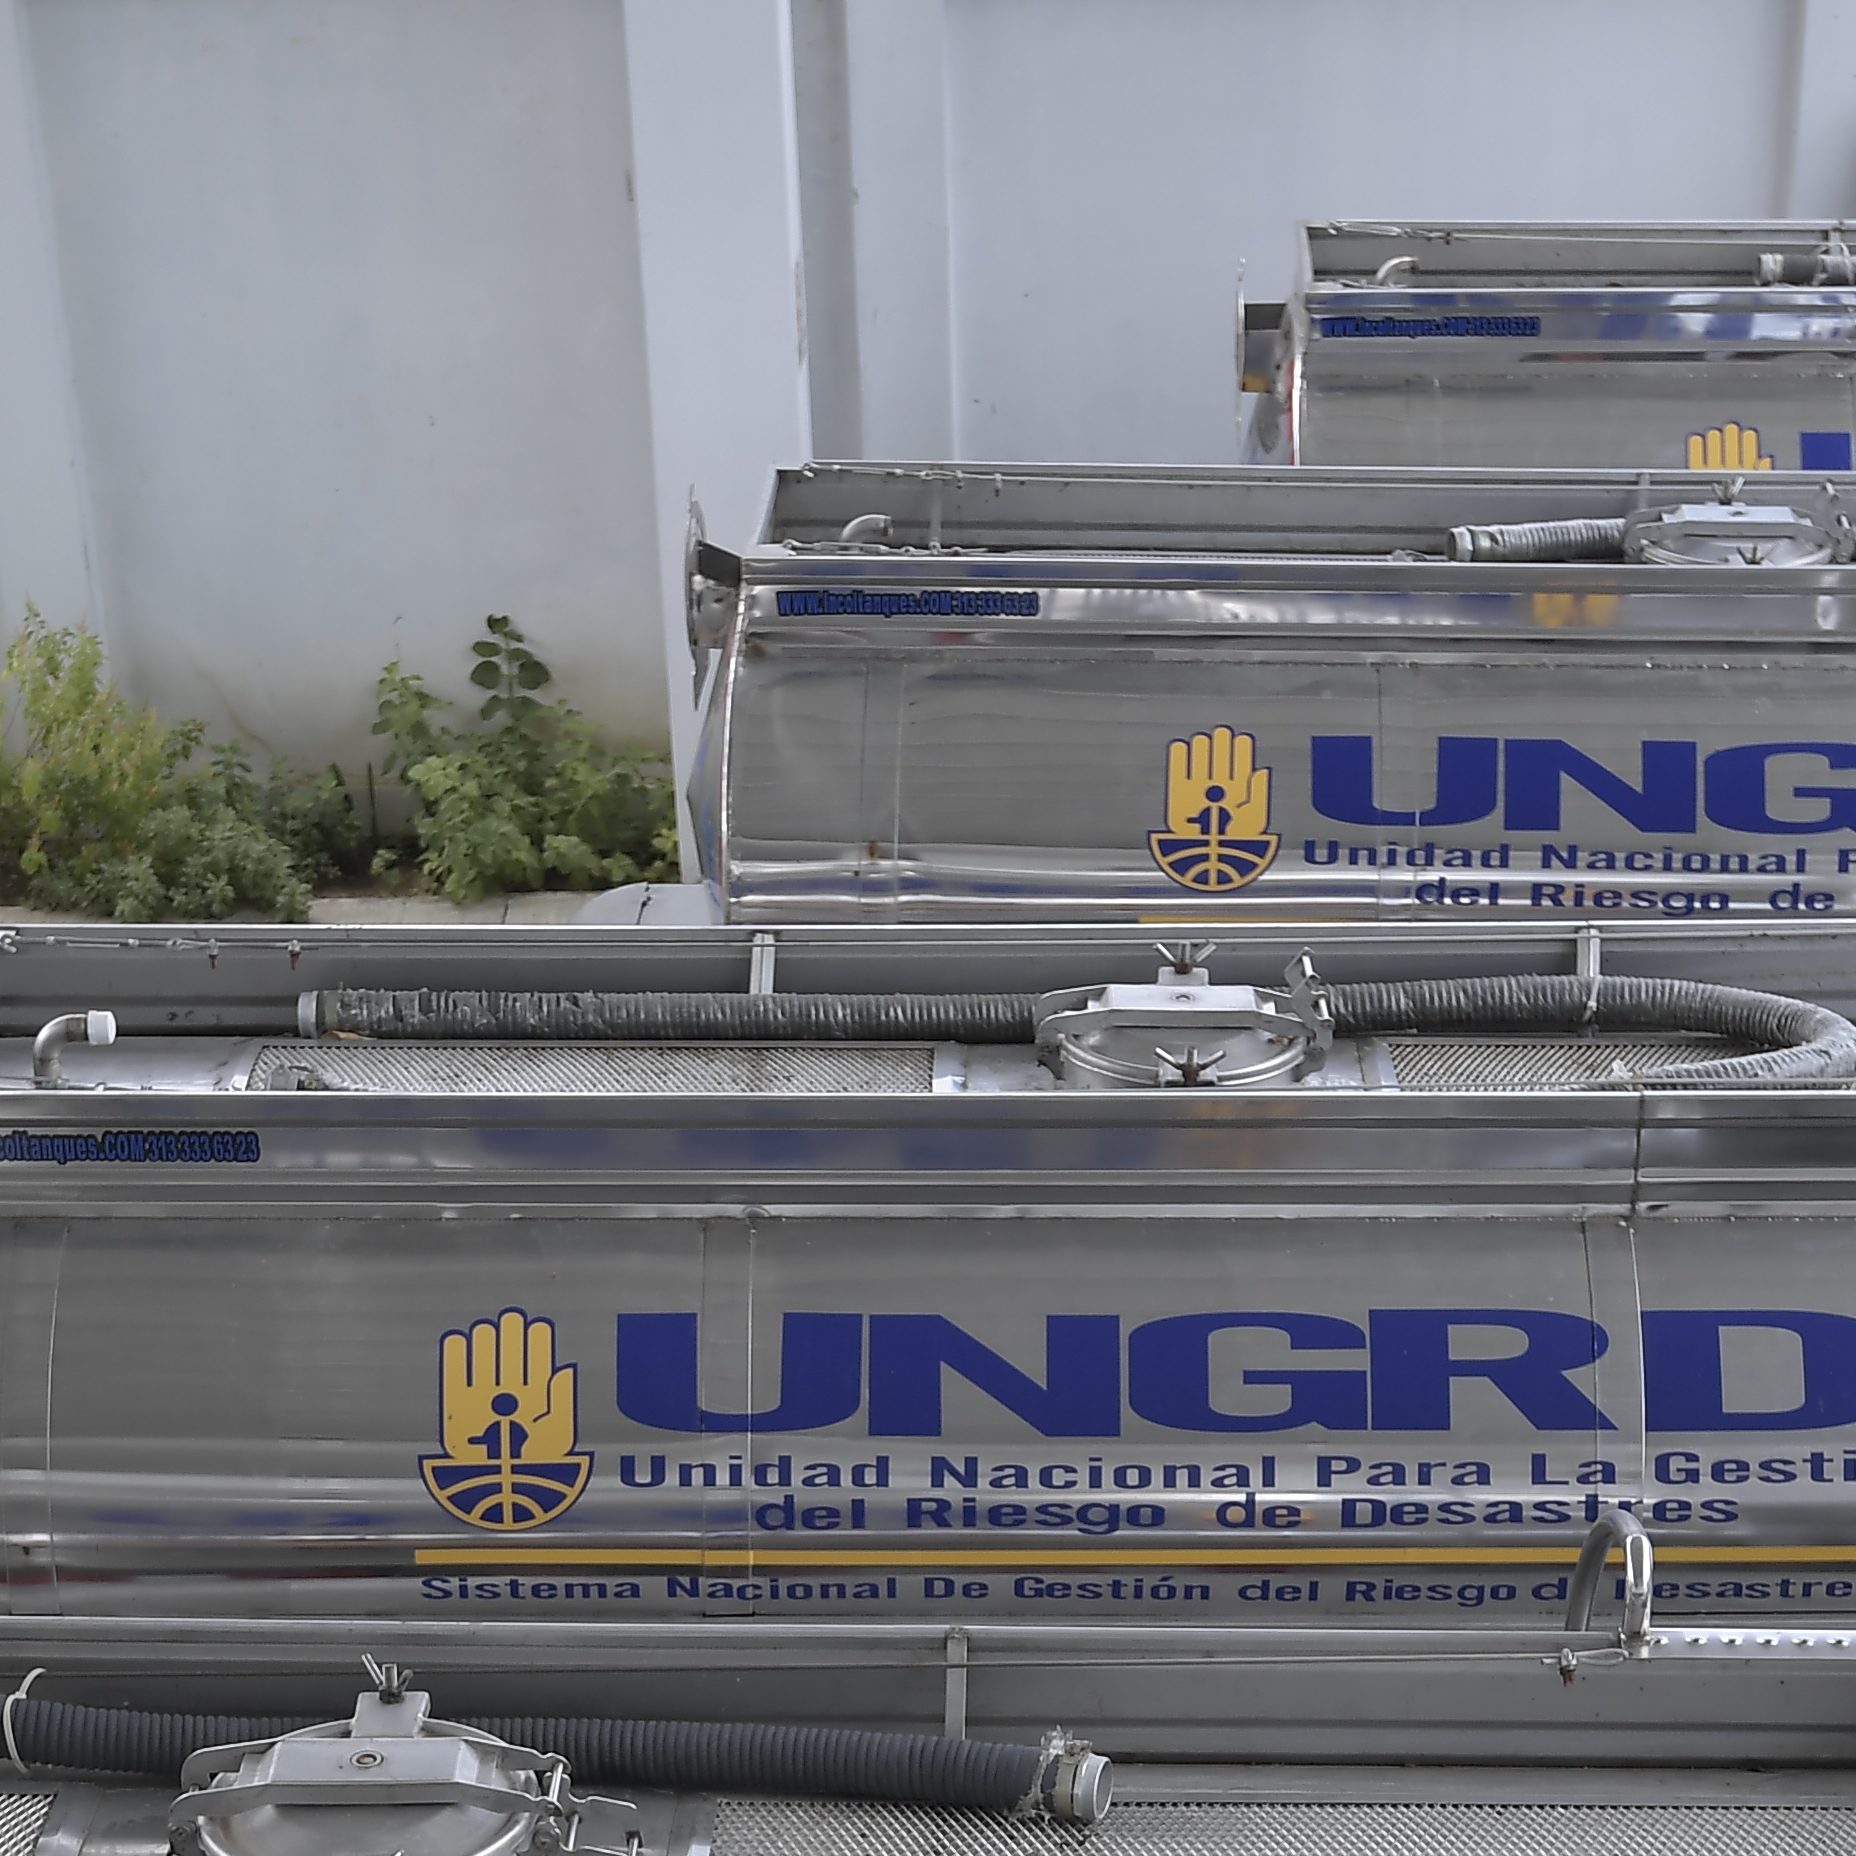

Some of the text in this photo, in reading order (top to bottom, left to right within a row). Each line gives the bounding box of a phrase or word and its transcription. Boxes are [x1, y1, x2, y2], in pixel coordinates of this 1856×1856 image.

[1304, 840, 1510, 870] Unidad
[1542, 844, 1806, 873] Nacional
[1414, 878, 1500, 906] del
[1531, 881, 1730, 916] Riesgo
[1769, 882, 1834, 912] de
[620, 1455, 889, 1489] Unidad
[931, 1455, 1275, 1489] Nacional
[1317, 1454, 1490, 1489] Para
[1532, 1453, 1615, 1485] La
[755, 1494, 866, 1531] del
[907, 1498, 1165, 1535] Riesgo
[1217, 1492, 1300, 1529] de
[422, 1576, 640, 1600] Sistema
[667, 1576, 896, 1600] Nacional
[924, 1577, 988, 1599] De
[1014, 1576, 1210, 1601] Gestión
[1239, 1579, 1318, 1601] del
[1346, 1579, 1516, 1607] Riesgo
[1532, 1577, 1568, 1600] d
